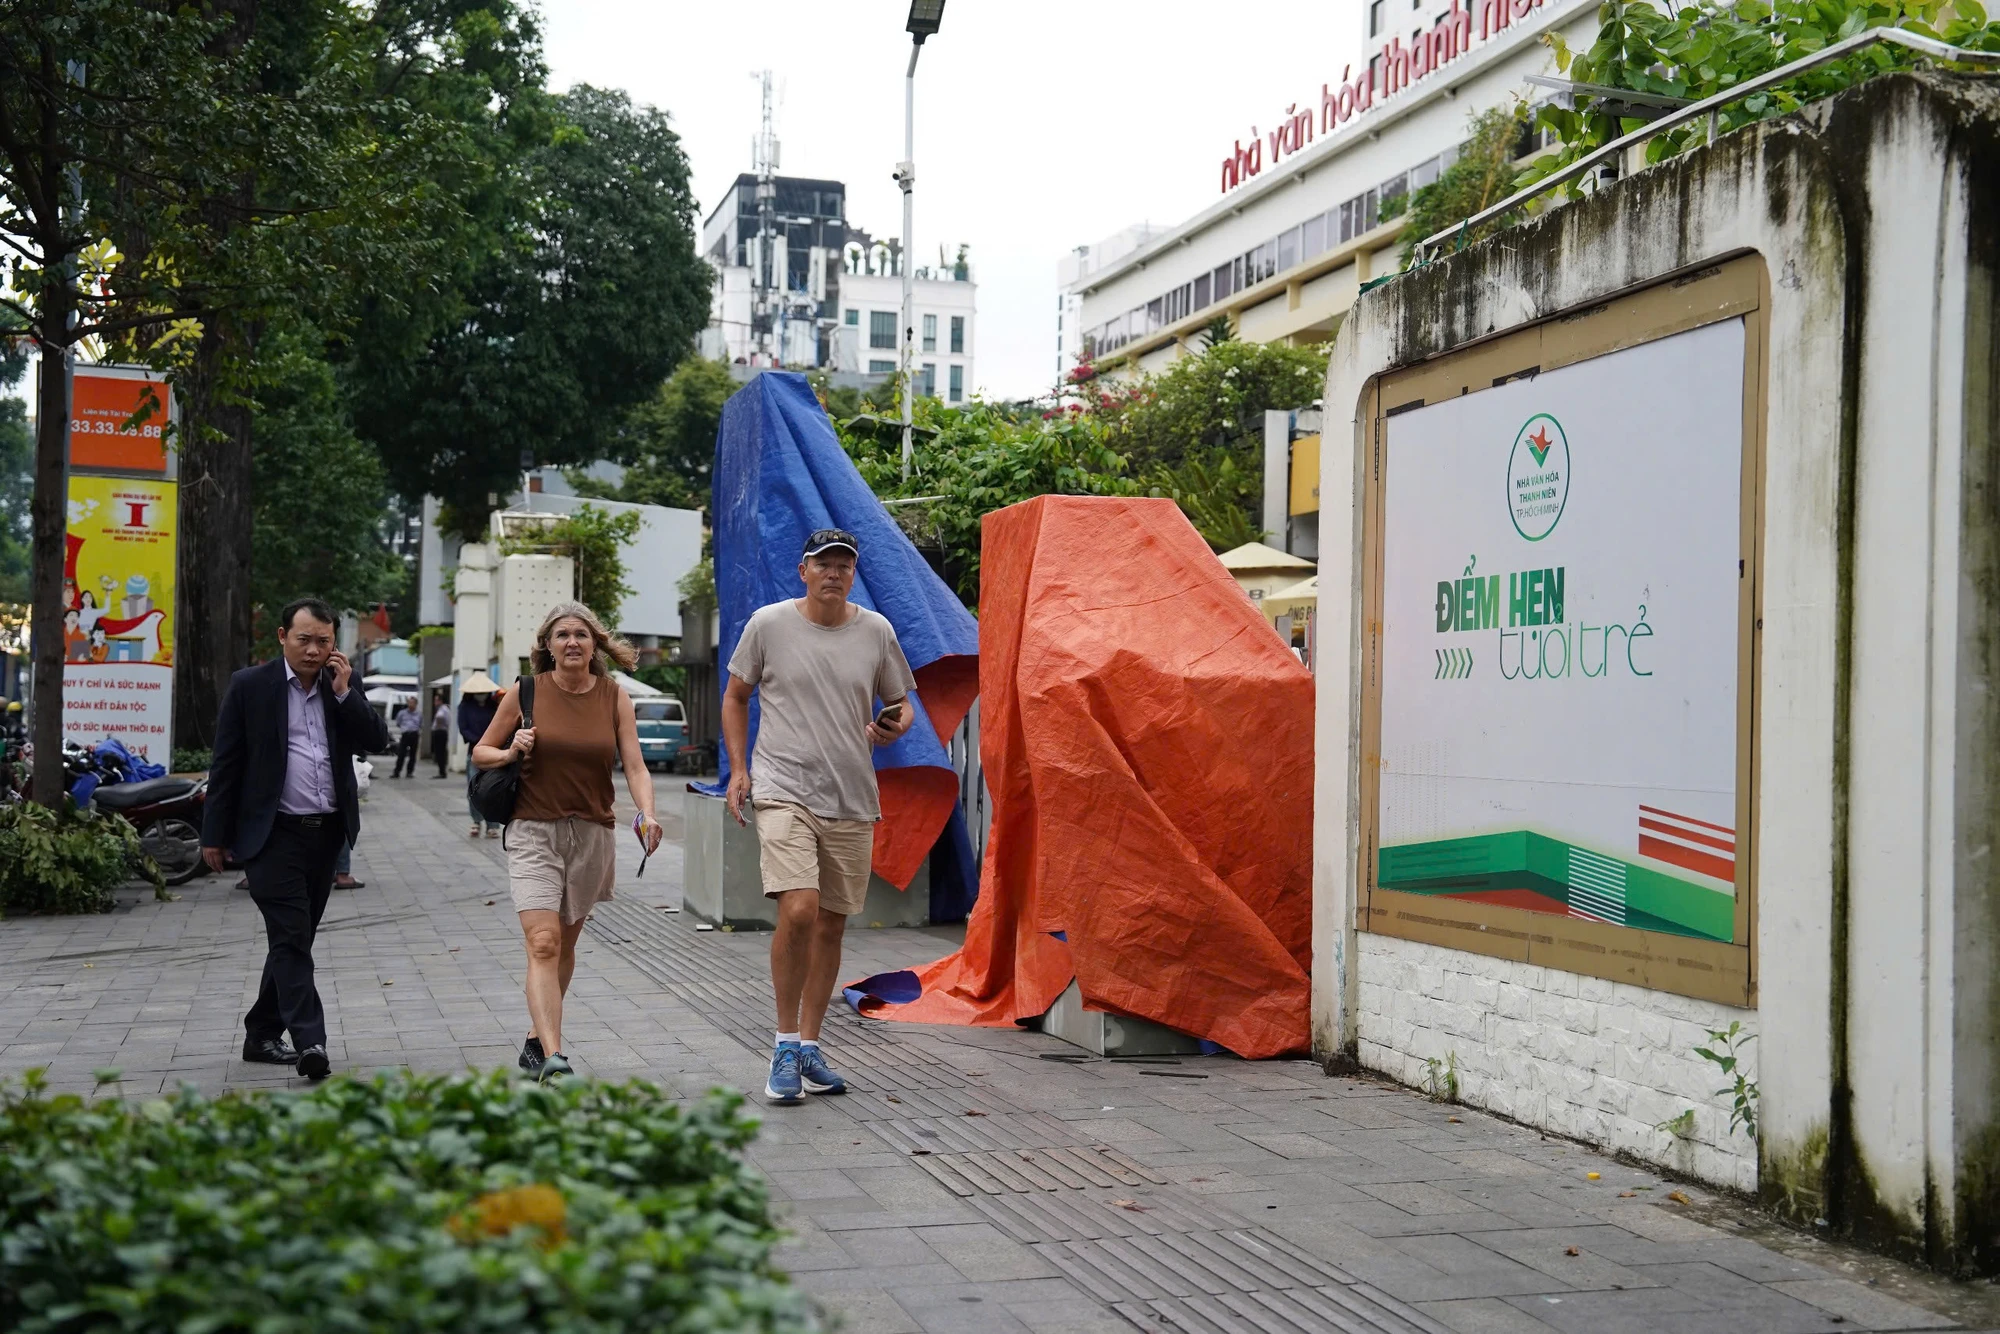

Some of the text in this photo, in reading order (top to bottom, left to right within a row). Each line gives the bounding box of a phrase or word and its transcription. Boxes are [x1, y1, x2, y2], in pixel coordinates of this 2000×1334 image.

[1221, 126, 1261, 193] nhà
[1269, 103, 1313, 163] văn
[1321, 64, 1374, 134] hóa
[1379, 0, 1470, 98] thanh
[1516, 470, 1560, 490] NHÀ VĂN HÓA
[1519, 486, 1557, 504] THANH NIÊN
[124, 502, 150, 527] I
[1435, 554, 1500, 633] ĐIỂM
[1580, 605, 1654, 677] trẻ
[86, 679, 102, 688] CHÍ
[104, 679, 116, 689] VÀ
[117, 679, 135, 690] SỨC
[136, 681, 161, 691] MẠNH
[67, 700, 92, 710] ĐOÀN
[94, 698, 108, 711] KẾT
[110, 700, 128, 711] DÂN
[130, 701, 147, 713] TỘC
[66, 720, 81, 731] VỚI
[83, 720, 100, 732] SỨC
[129, 722, 149, 733] THỜI
[150, 724, 165, 735] ĐẠI
